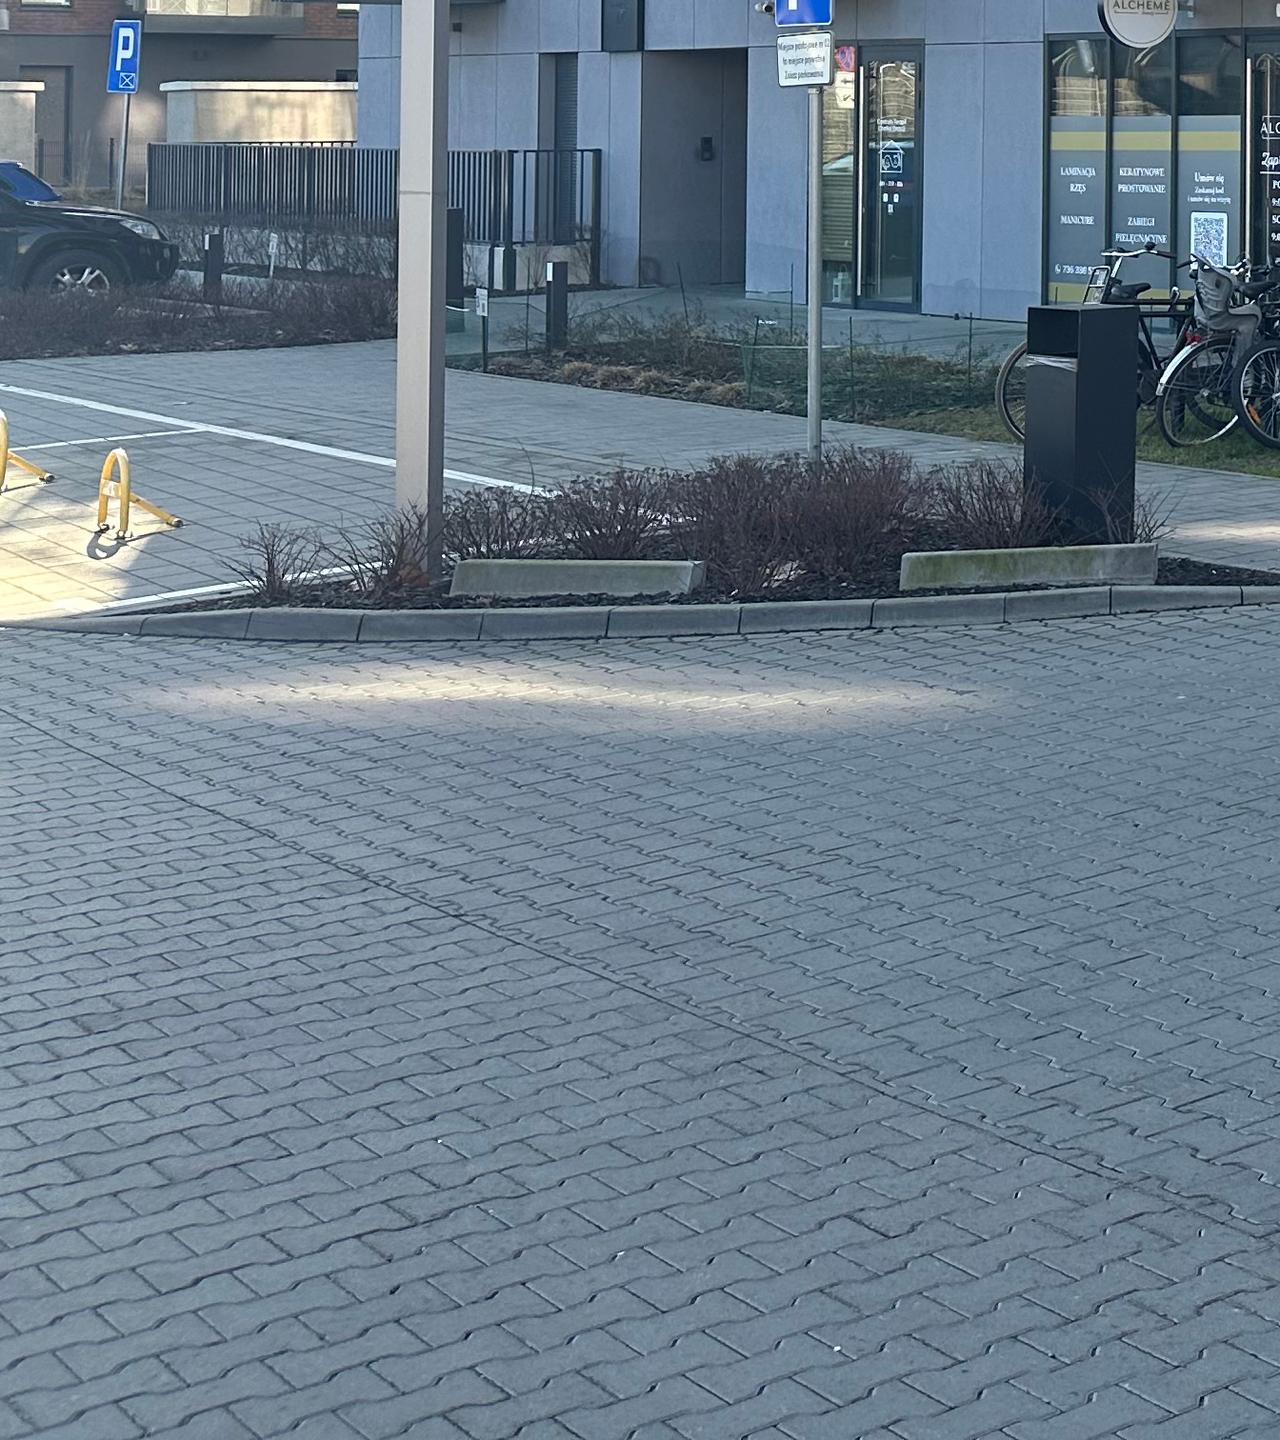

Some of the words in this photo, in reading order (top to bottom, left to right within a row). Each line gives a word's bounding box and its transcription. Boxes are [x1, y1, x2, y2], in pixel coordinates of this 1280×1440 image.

[115, 27, 134, 71] P
[1060, 167, 1096, 178] LAMINACJA
[1119, 167, 1165, 177] KERATYNOWE
[1069, 183, 1086, 194] RZĘS
[1117, 184, 1166, 193] PROSTOWANIE
[1060, 215, 1095, 225] MANICURE
[1127, 217, 1155, 227] ZABIEGI
